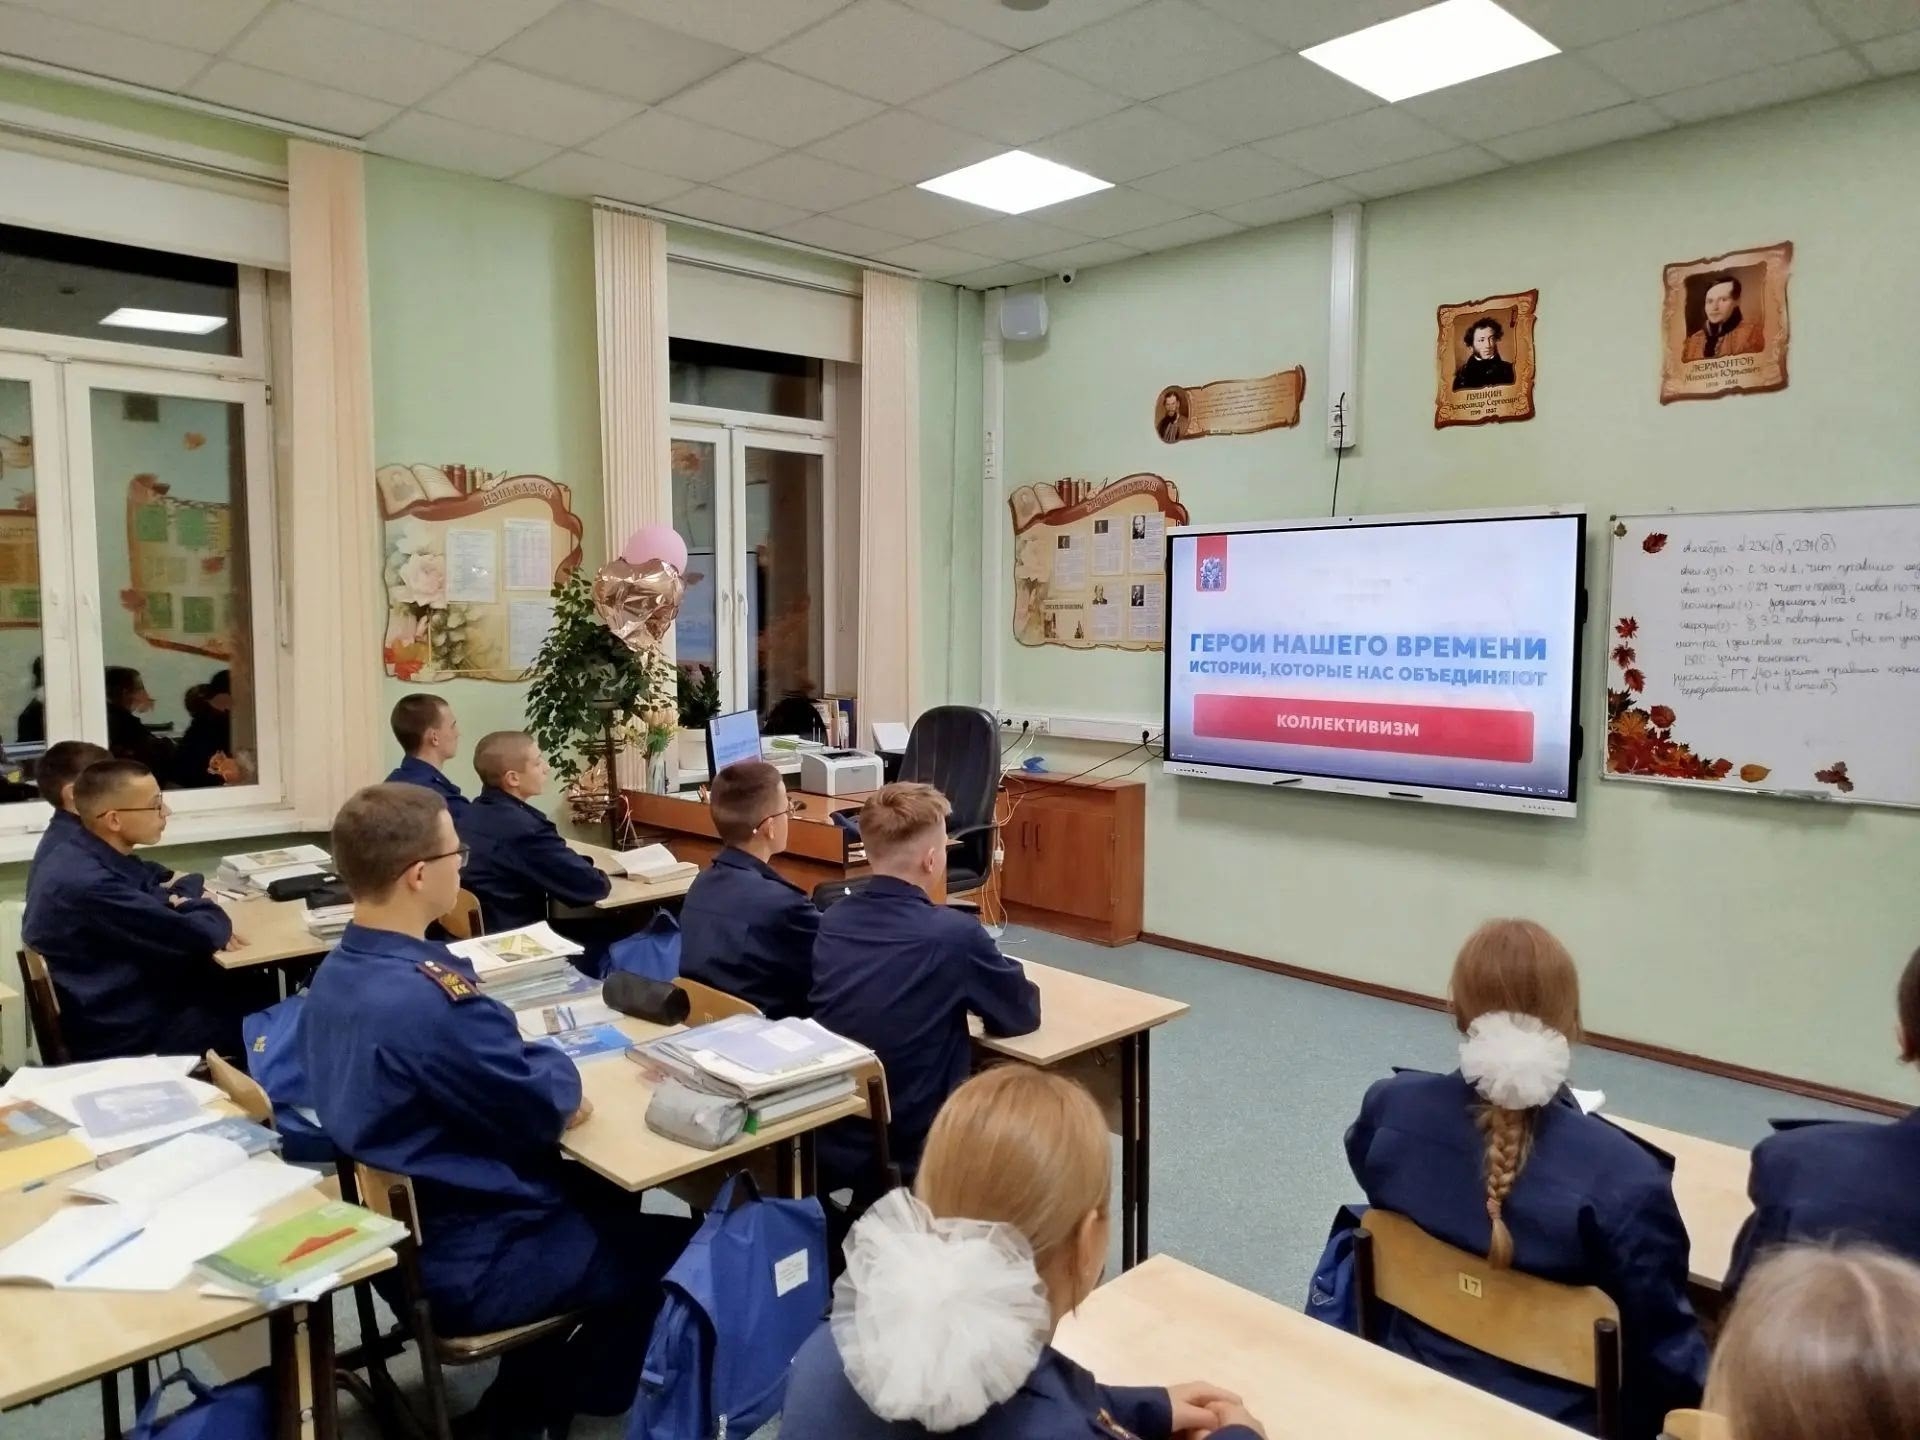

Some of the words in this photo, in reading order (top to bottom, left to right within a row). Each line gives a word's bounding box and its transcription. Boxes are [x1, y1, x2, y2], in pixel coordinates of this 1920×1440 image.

[1690, 356, 1754, 372] ЛЕРМОНТОВ
[1466, 389, 1502, 400] ПУШКИН
[482, 487, 512, 507] НАШ
[1190, 633, 1265, 653] ГЕРОИ
[1273, 634, 1388, 656] НАШЕГО
[1396, 635, 1547, 660] ВРЕМЕНИ
[1189, 660, 1267, 678] ИСТОРИИ,
[1270, 662, 1353, 679] КОТОРЫЕ
[1357, 665, 1394, 680] НАС
[1398, 666, 1548, 687] ОБЪЕДИНЯЮТ
[1276, 713, 1420, 737] КОЛЛЕКТИВИЗМ
[1463, 1278, 1479, 1293] 17
